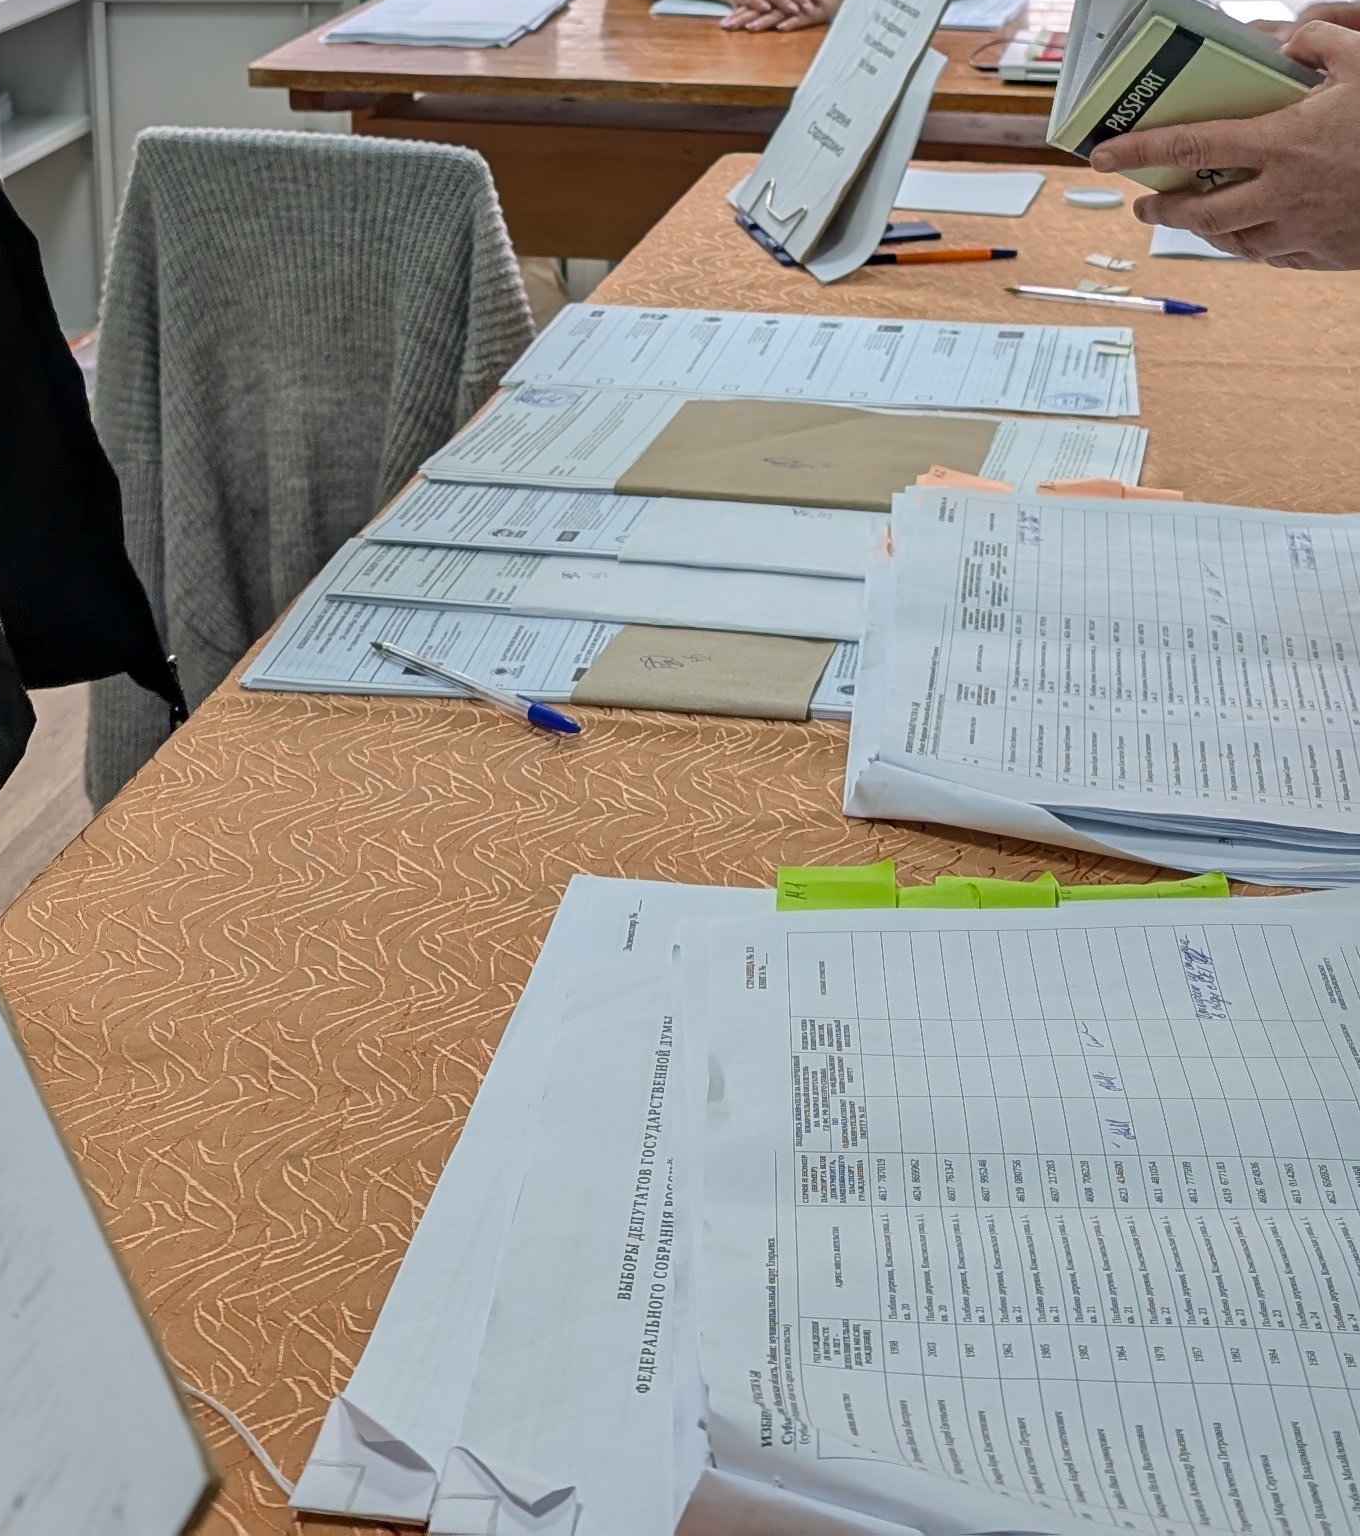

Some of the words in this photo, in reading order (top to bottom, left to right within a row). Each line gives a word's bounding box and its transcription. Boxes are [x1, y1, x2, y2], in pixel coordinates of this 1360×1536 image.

[1105, 69, 1167, 133] PASSPORT
[654, 1015, 674, 1048] ДУМЫ
[639, 1049, 672, 1166] ГОСУДАРСТВЕННОЙ
[626, 1169, 654, 1242] ДЕПУТАТОВ
[818, 1169, 827, 1203] ПАСПОРТА
[847, 1163, 855, 1194] ПАСПОРТ
[855, 1158, 865, 1202] ГРАЖДАНИНА
[616, 1243, 640, 1301] ВЫБОРЫ
[634, 1282, 667, 1395] ФЕДЕРАЛЬНОГО
[652, 1210, 674, 1281] СОБРАНИЯ
